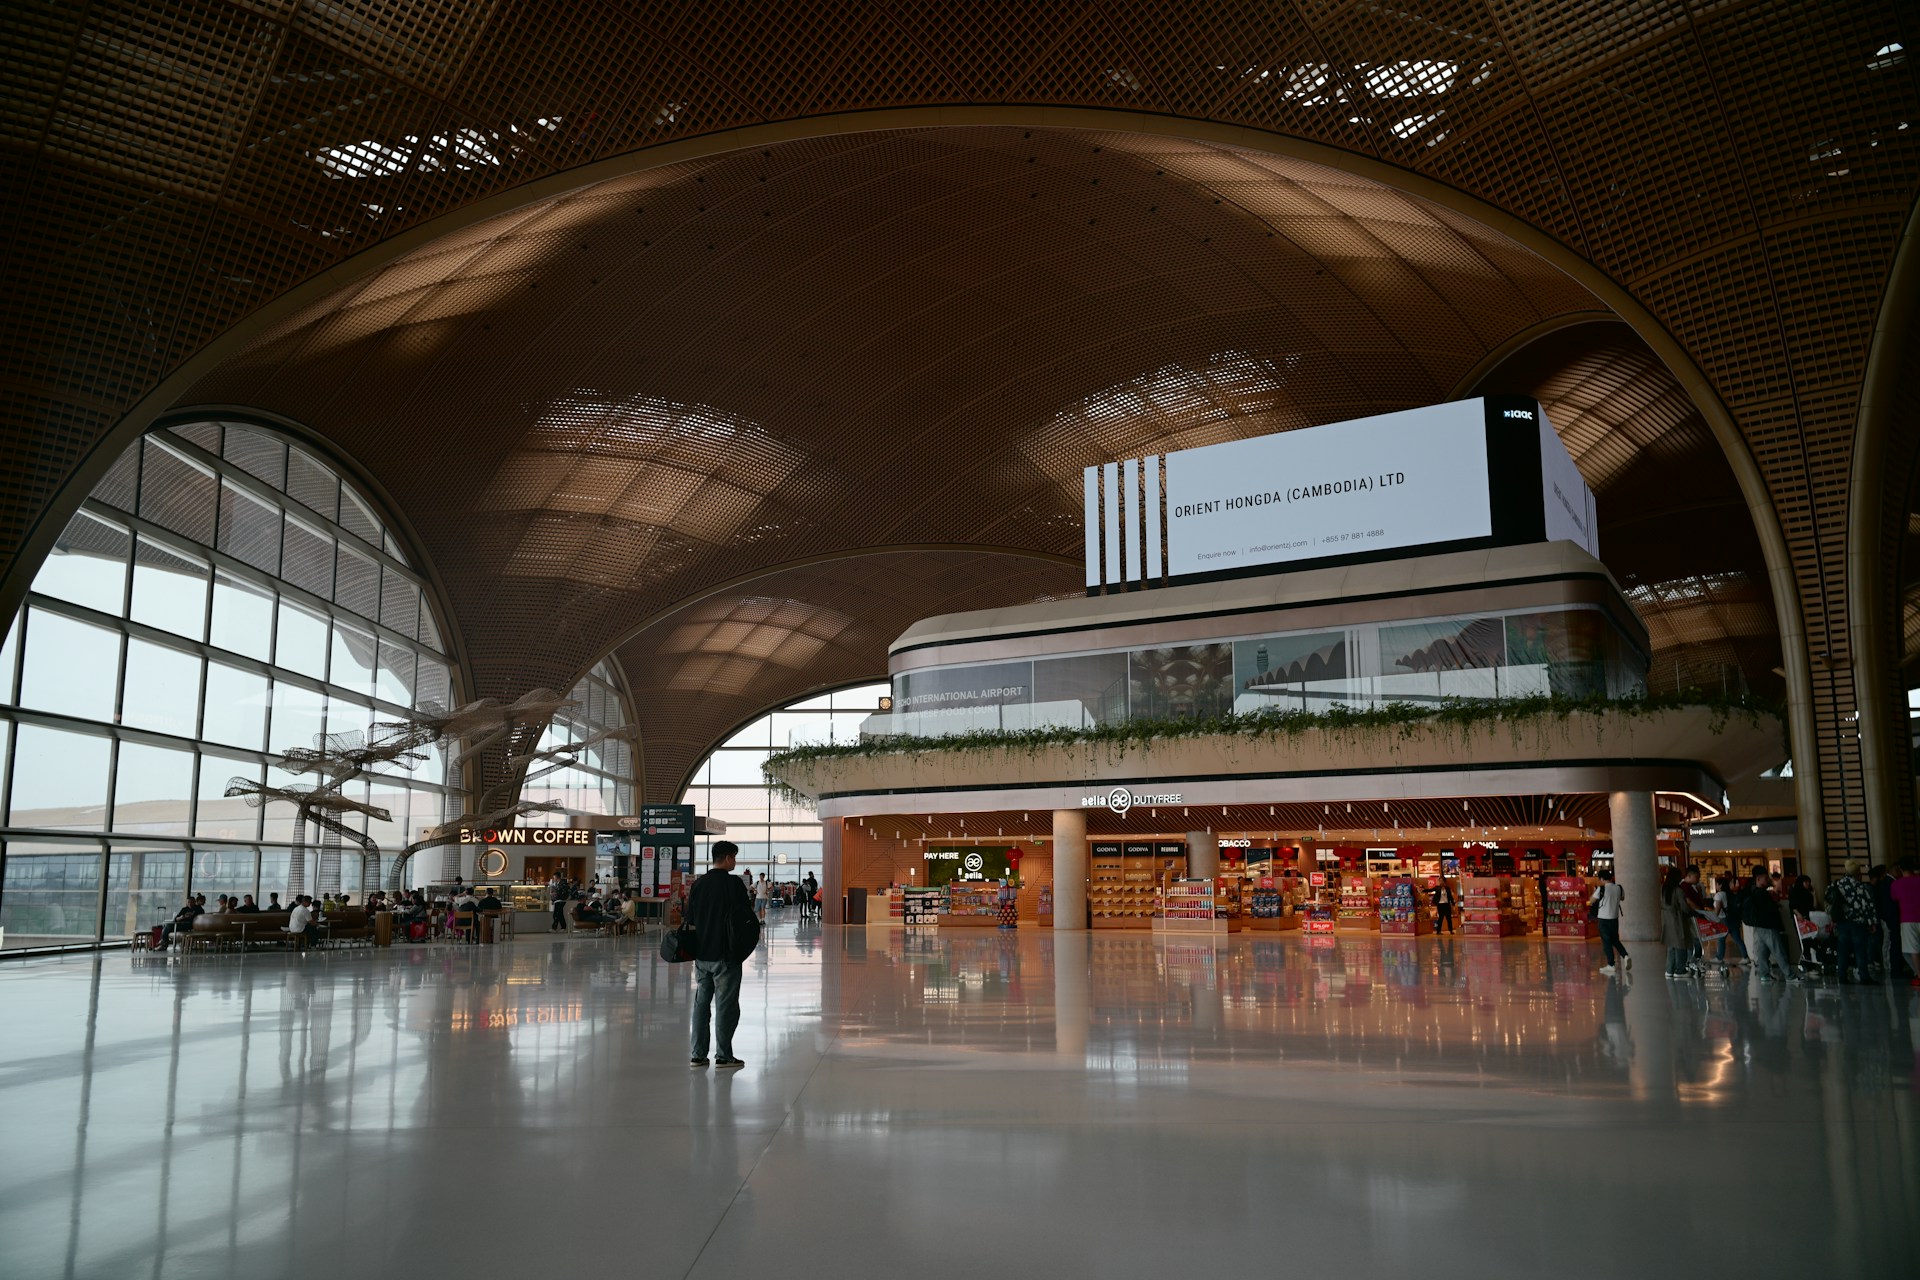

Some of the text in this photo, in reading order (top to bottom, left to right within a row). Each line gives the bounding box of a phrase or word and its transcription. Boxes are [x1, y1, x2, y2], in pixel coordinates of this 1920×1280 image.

[1175, 472, 1405, 518] ORIENT HONGDA (CAMBODIA) LTD
[1197, 529, 1385, 560] Enquire now info@orientzj.com +855 97 881 4888
[912, 690, 978, 706] INTERNATIONAL
[981, 686, 1023, 698] AIRPORT
[941, 706, 966, 717] FOOD
[968, 703, 1000, 715] COURT
[1082, 795, 1107, 806] aelia
[1133, 793, 1182, 805] DUTYFREE
[533, 829, 589, 844] COFFEE
[1218, 840, 1251, 848] OBACCO
[1463, 841, 1499, 850] ALHOL
[923, 852, 960, 860] PAY HERE
